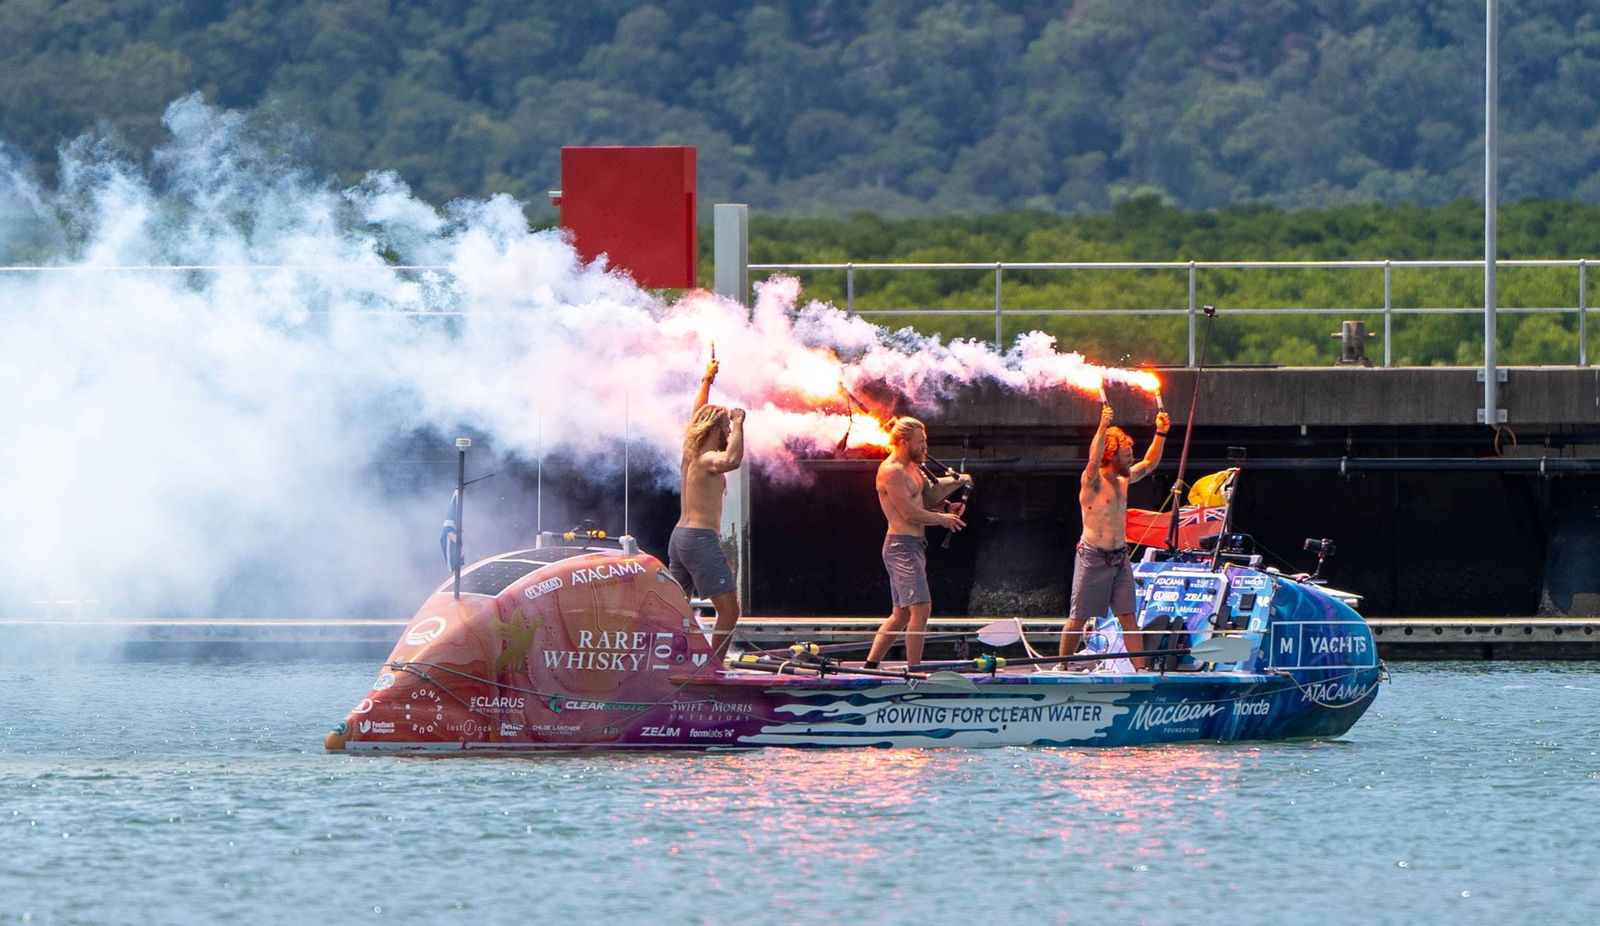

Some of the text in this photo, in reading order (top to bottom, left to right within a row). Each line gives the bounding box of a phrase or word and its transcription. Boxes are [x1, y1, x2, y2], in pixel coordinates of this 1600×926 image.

[571, 562, 646, 586] ATACAMA
[1155, 578, 1184, 586] ATACAMA
[1184, 592, 1213, 602] ZELIM
[579, 630, 647, 650] RARE
[1280, 635, 1367, 654] M YACHTS
[543, 651, 645, 671] WHISKY
[1301, 682, 1367, 702] ATACAMA
[476, 696, 525, 708] CLARUS
[565, 700, 645, 712] CLEARROUTE
[670, 700, 753, 712] SWIFT MORRIS
[1232, 699, 1270, 716] norda
[876, 705, 1102, 724] ROWING FOR CLEAN WATER
[1127, 697, 1225, 731] Maclean
[640, 726, 680, 737] ZELIM
[690, 728, 723, 738] formlabs
